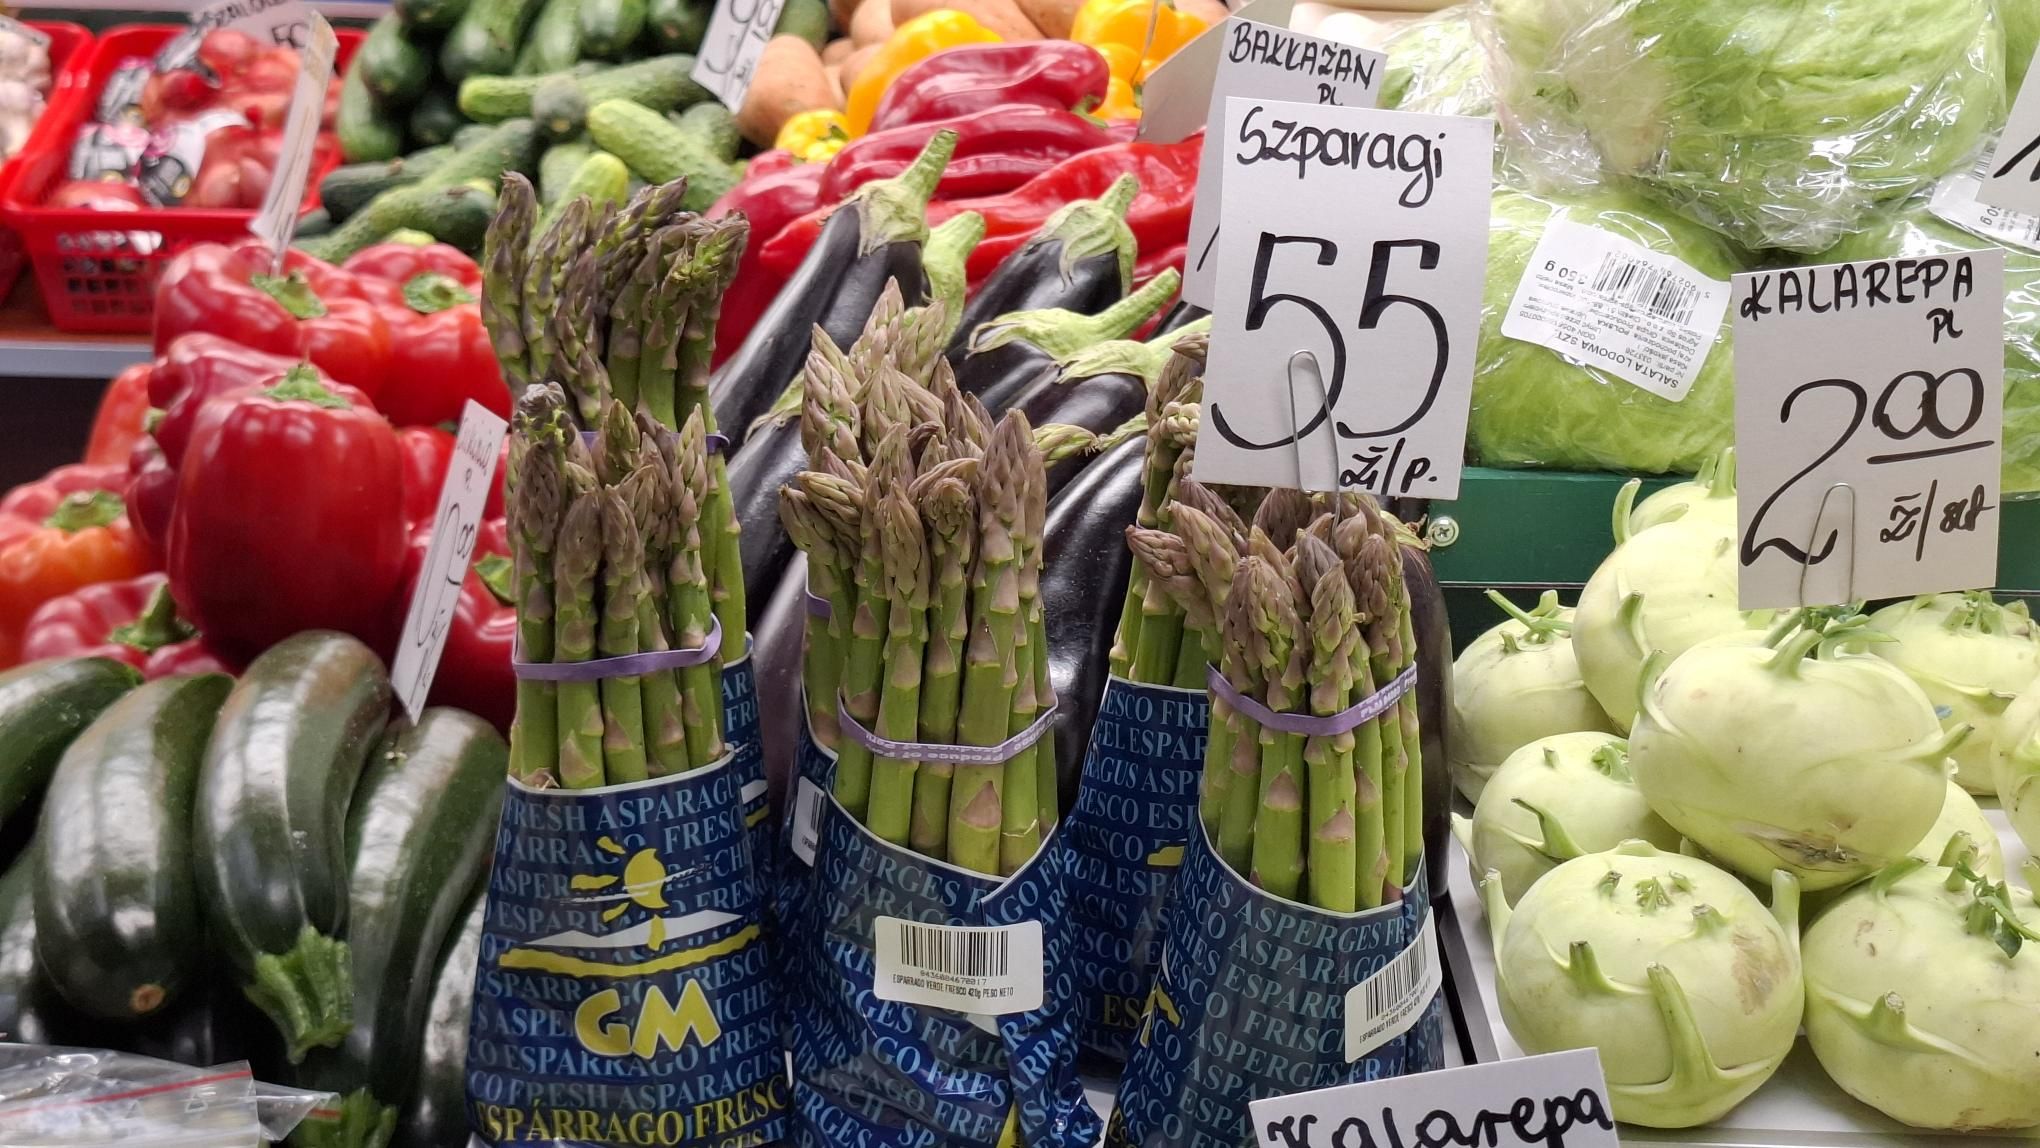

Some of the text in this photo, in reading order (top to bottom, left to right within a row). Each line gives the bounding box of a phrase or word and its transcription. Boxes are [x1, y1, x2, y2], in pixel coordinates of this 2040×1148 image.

[1237, 106, 1446, 208] Szparagi
[1740, 256, 1974, 321] KALAREPA
[1211, 231, 1449, 450] 55
[1579, 339, 1632, 367] LODOWA
[1926, 307, 1963, 344] PL
[824, 815, 961, 908] ASPERGES
[1234, 900, 1383, 953] ASPERGES
[575, 978, 722, 1060] GM
[618, 1050, 782, 1110] ASPARAGUS
[1187, 1024, 1340, 1088] ASPERGES
